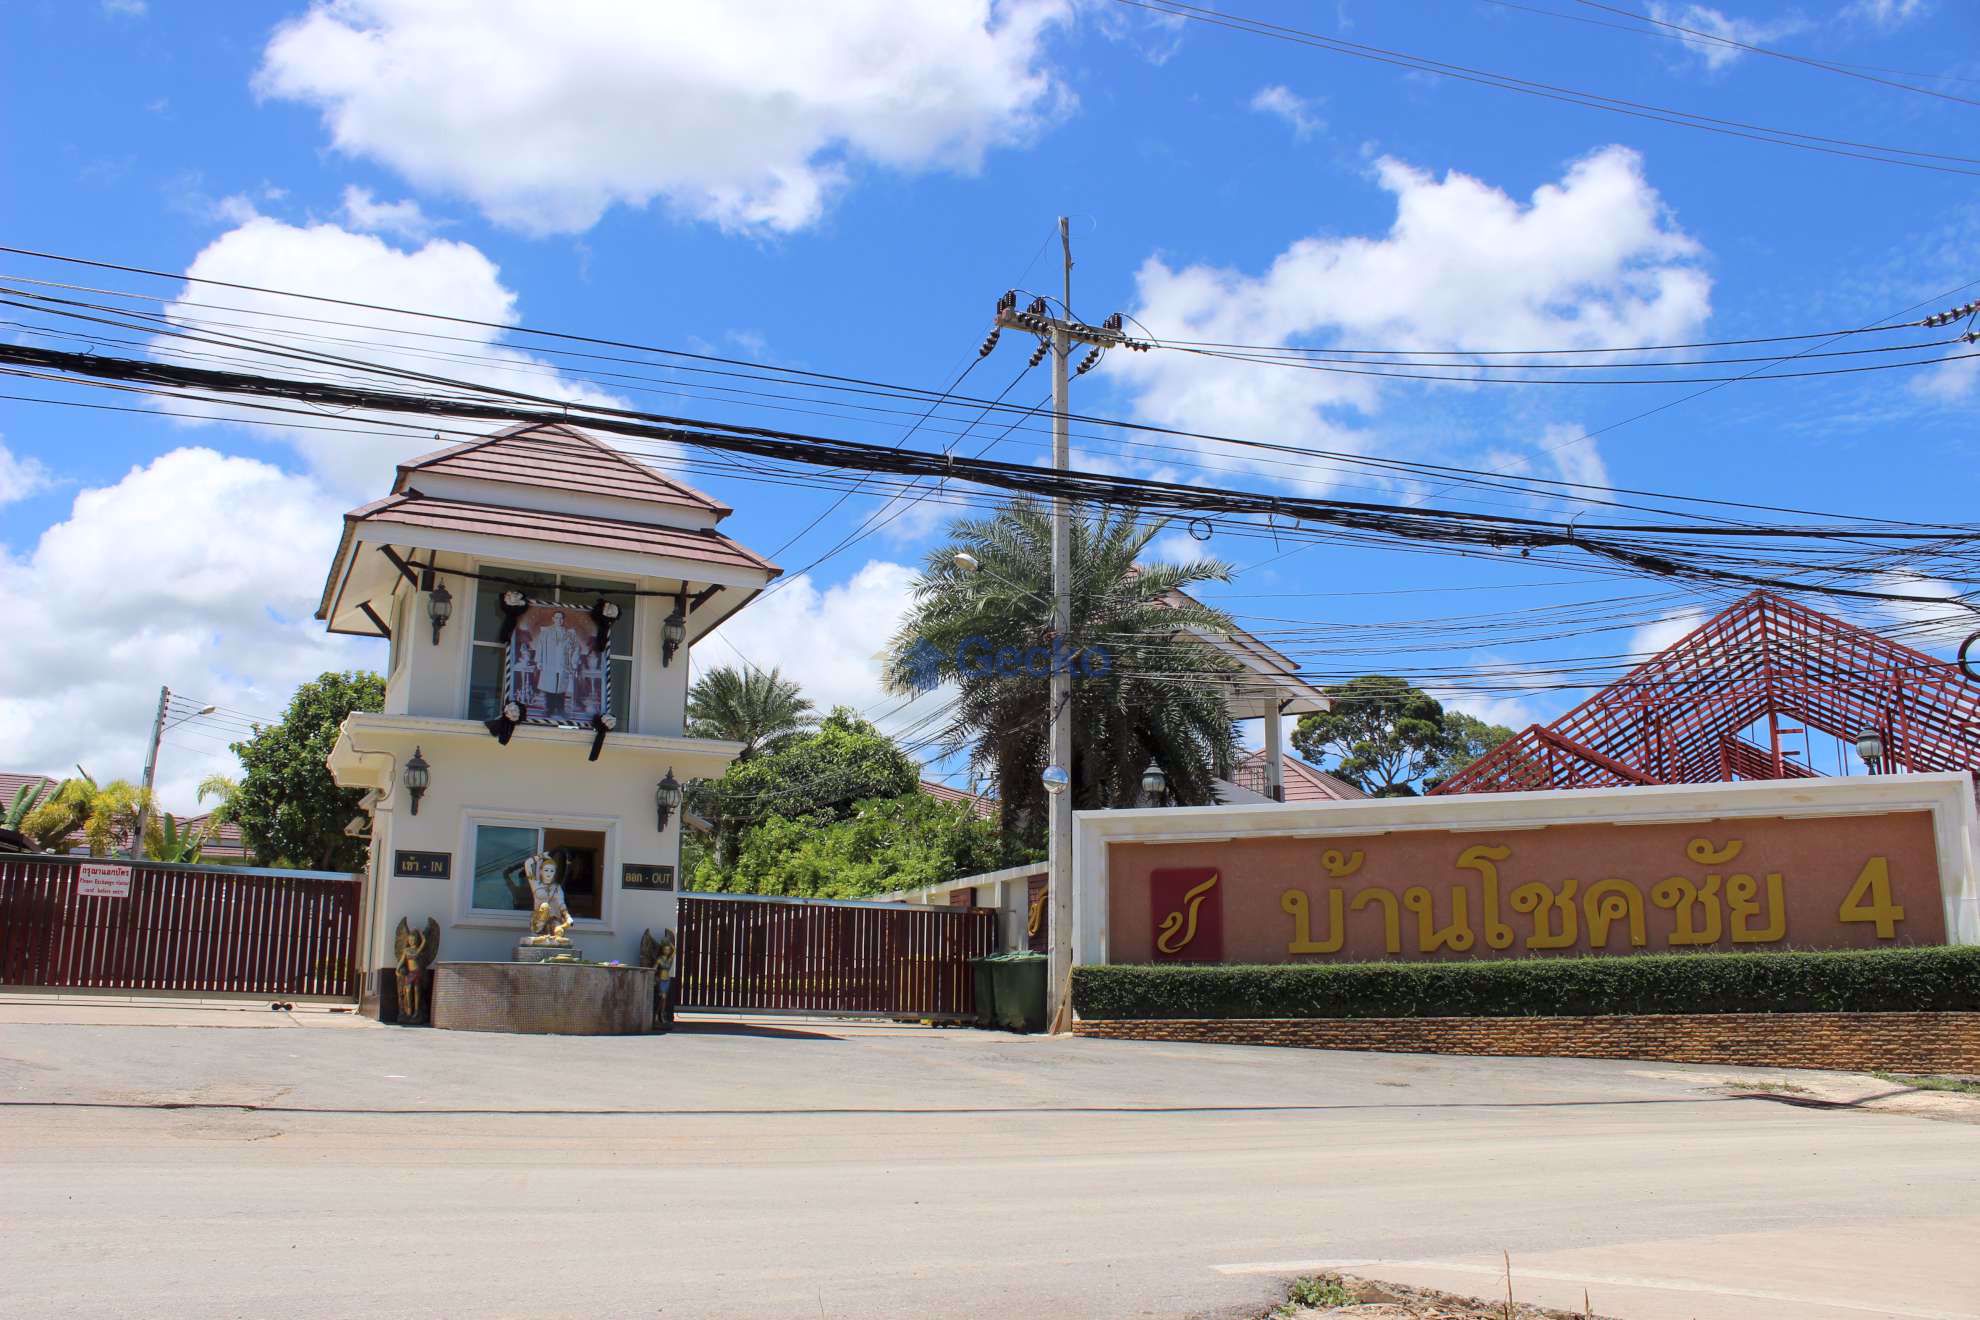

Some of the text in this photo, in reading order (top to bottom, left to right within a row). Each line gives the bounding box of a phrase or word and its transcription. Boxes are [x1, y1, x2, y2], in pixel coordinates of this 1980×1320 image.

[401, 856, 443, 872] เข้า IN
[625, 872, 672, 884] ออก OUT
[1280, 838, 1904, 955] บ้านโชคชัย 4
